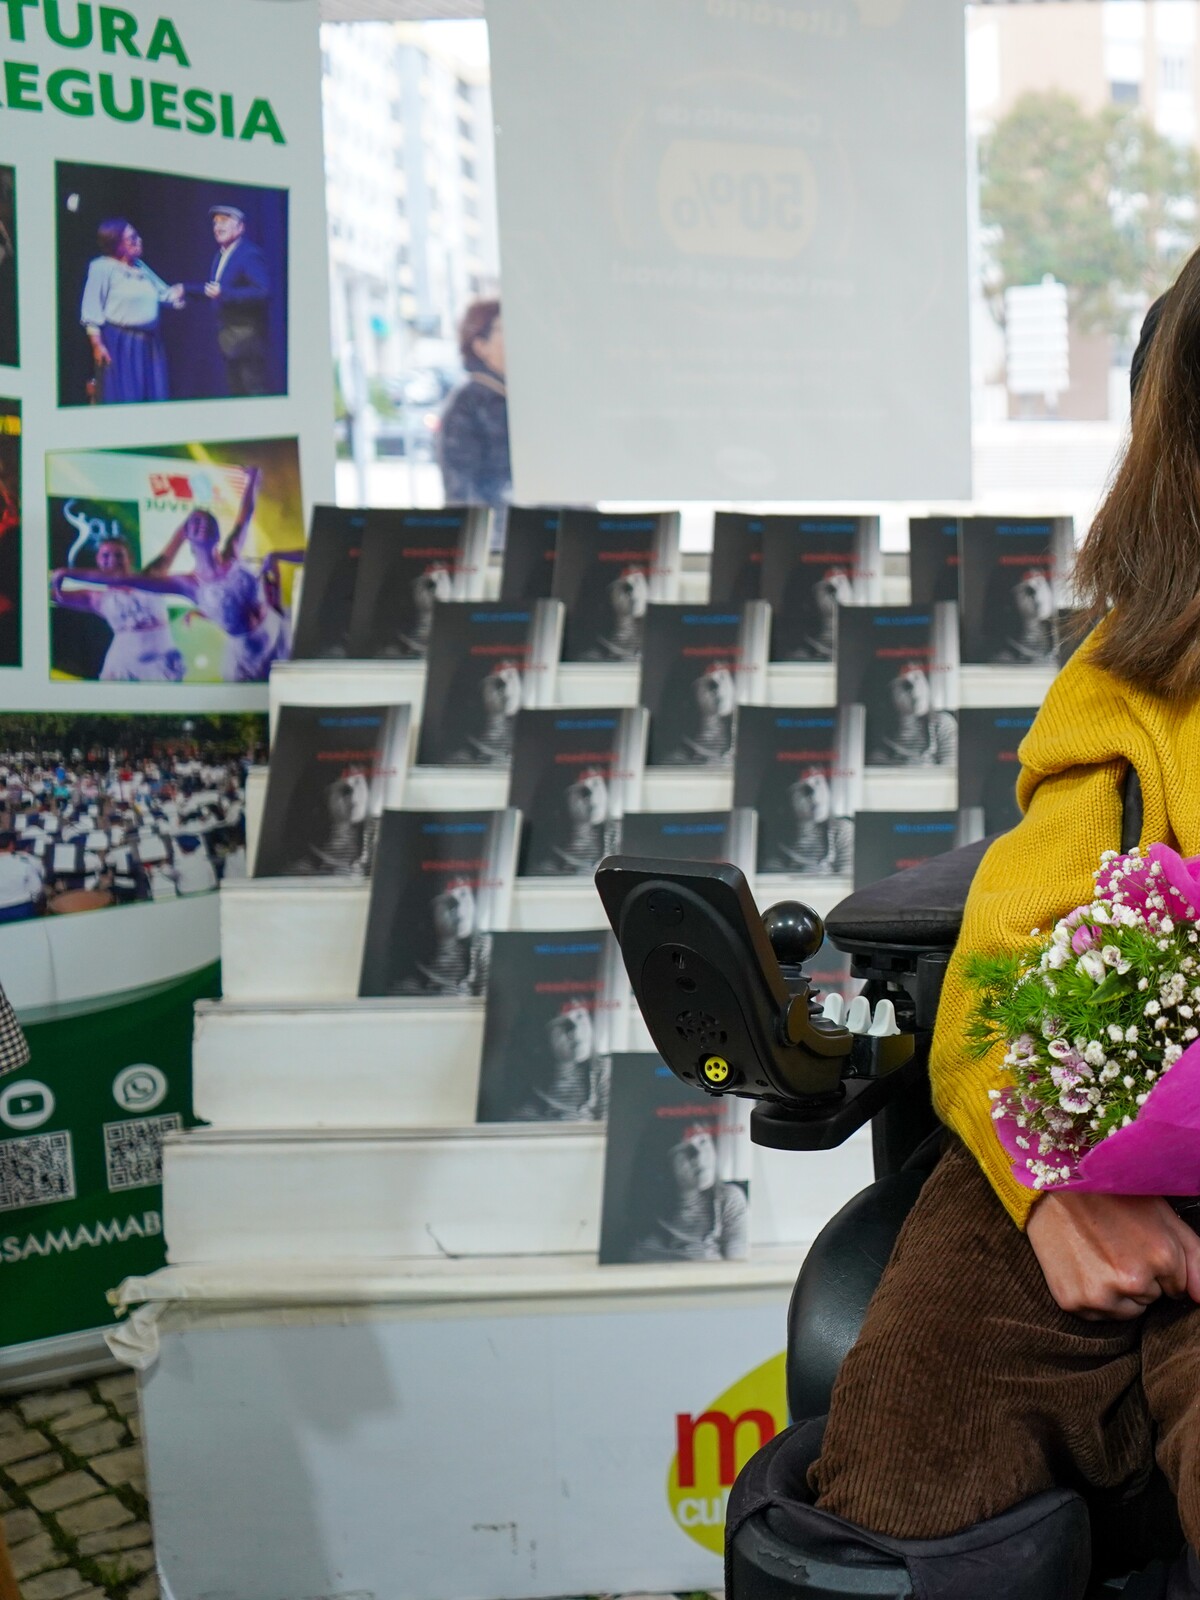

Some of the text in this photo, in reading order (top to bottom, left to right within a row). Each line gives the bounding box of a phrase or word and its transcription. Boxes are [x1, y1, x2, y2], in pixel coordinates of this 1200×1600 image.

[3, 0, 191, 67] TURA
[0, 60, 287, 144] EGUESIA
[0, 1210, 162, 1264] SAMAMAB
